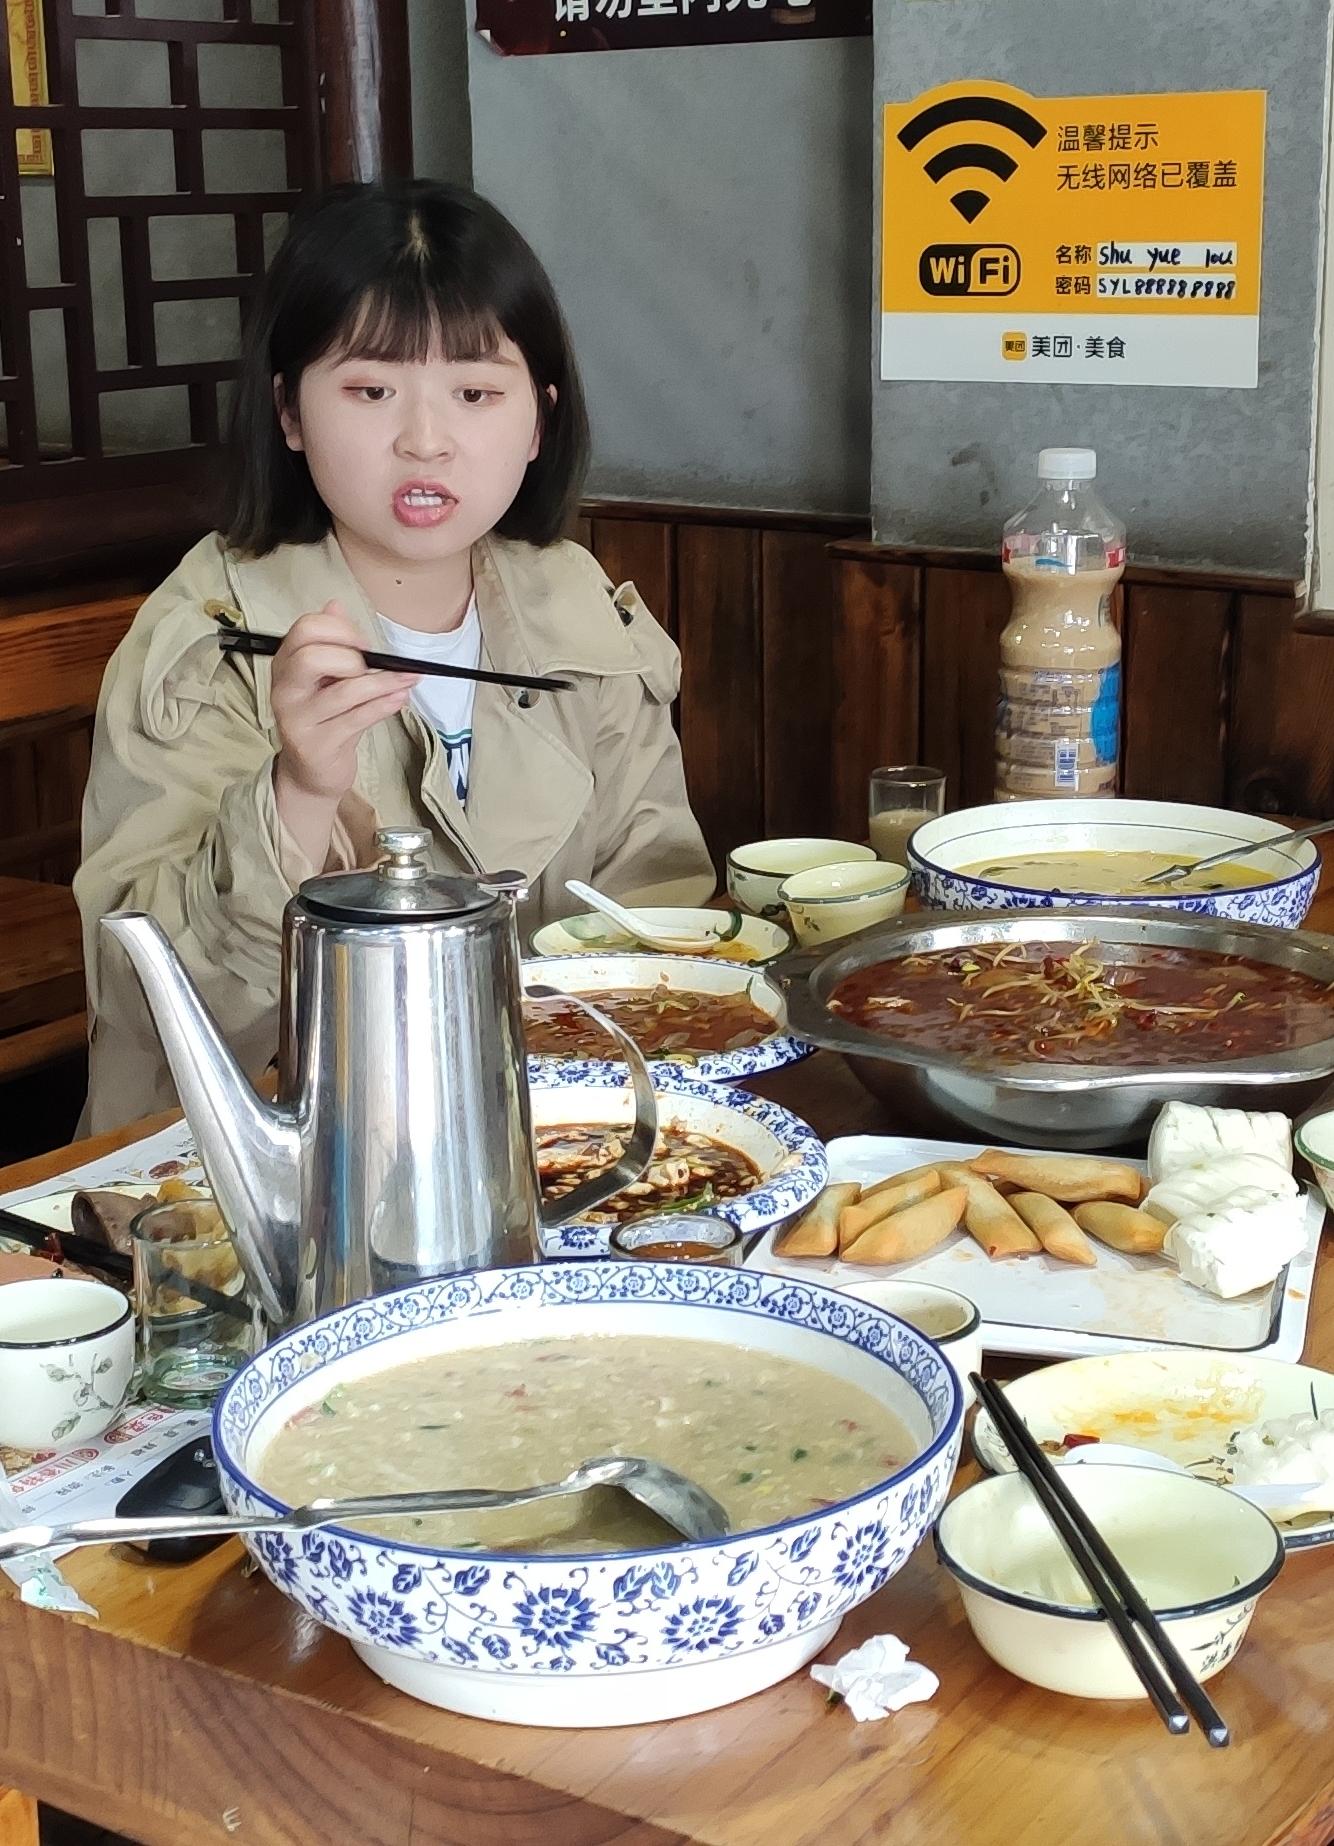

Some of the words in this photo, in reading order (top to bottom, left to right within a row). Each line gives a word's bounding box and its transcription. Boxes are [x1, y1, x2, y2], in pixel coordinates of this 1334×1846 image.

[1057, 123, 1159, 152] 温馨提示
[1056, 159, 1238, 191] 无线网络已覆盖
[928, 254, 1010, 285] WiFi
[1055, 244, 1092, 265] 名称
[1146, 247, 1182, 273] yue
[1055, 275, 1091, 296] 密码
